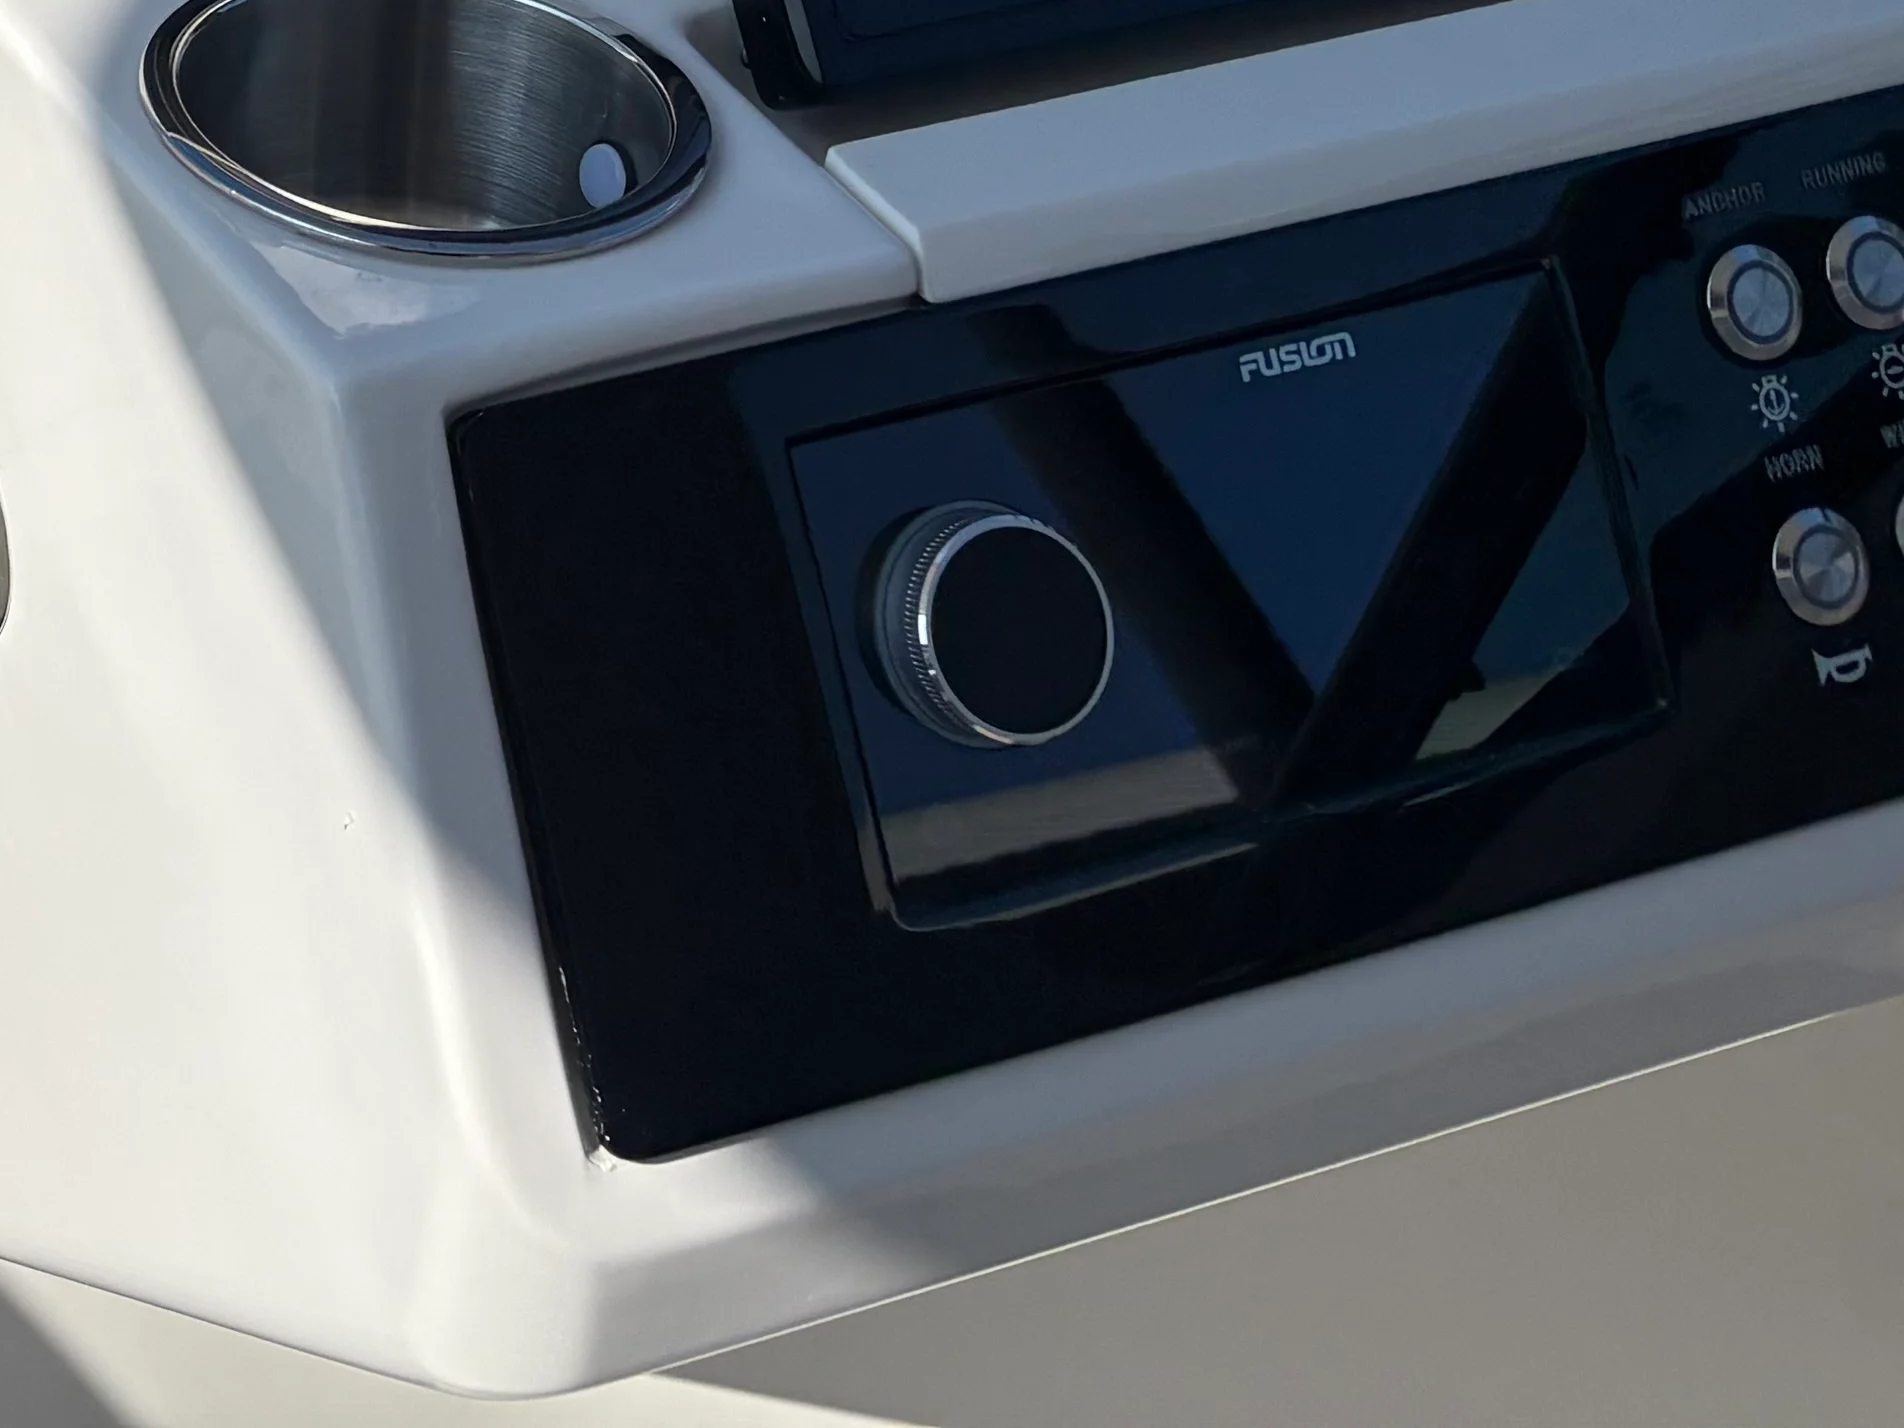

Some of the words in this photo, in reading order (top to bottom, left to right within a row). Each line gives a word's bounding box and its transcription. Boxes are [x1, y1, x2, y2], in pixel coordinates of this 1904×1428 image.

[1802, 151, 1887, 190] RUNNING
[1683, 180, 1767, 220] ANCHOR
[1238, 331, 1357, 383] FUSION
[1764, 443, 1825, 484] HORN
